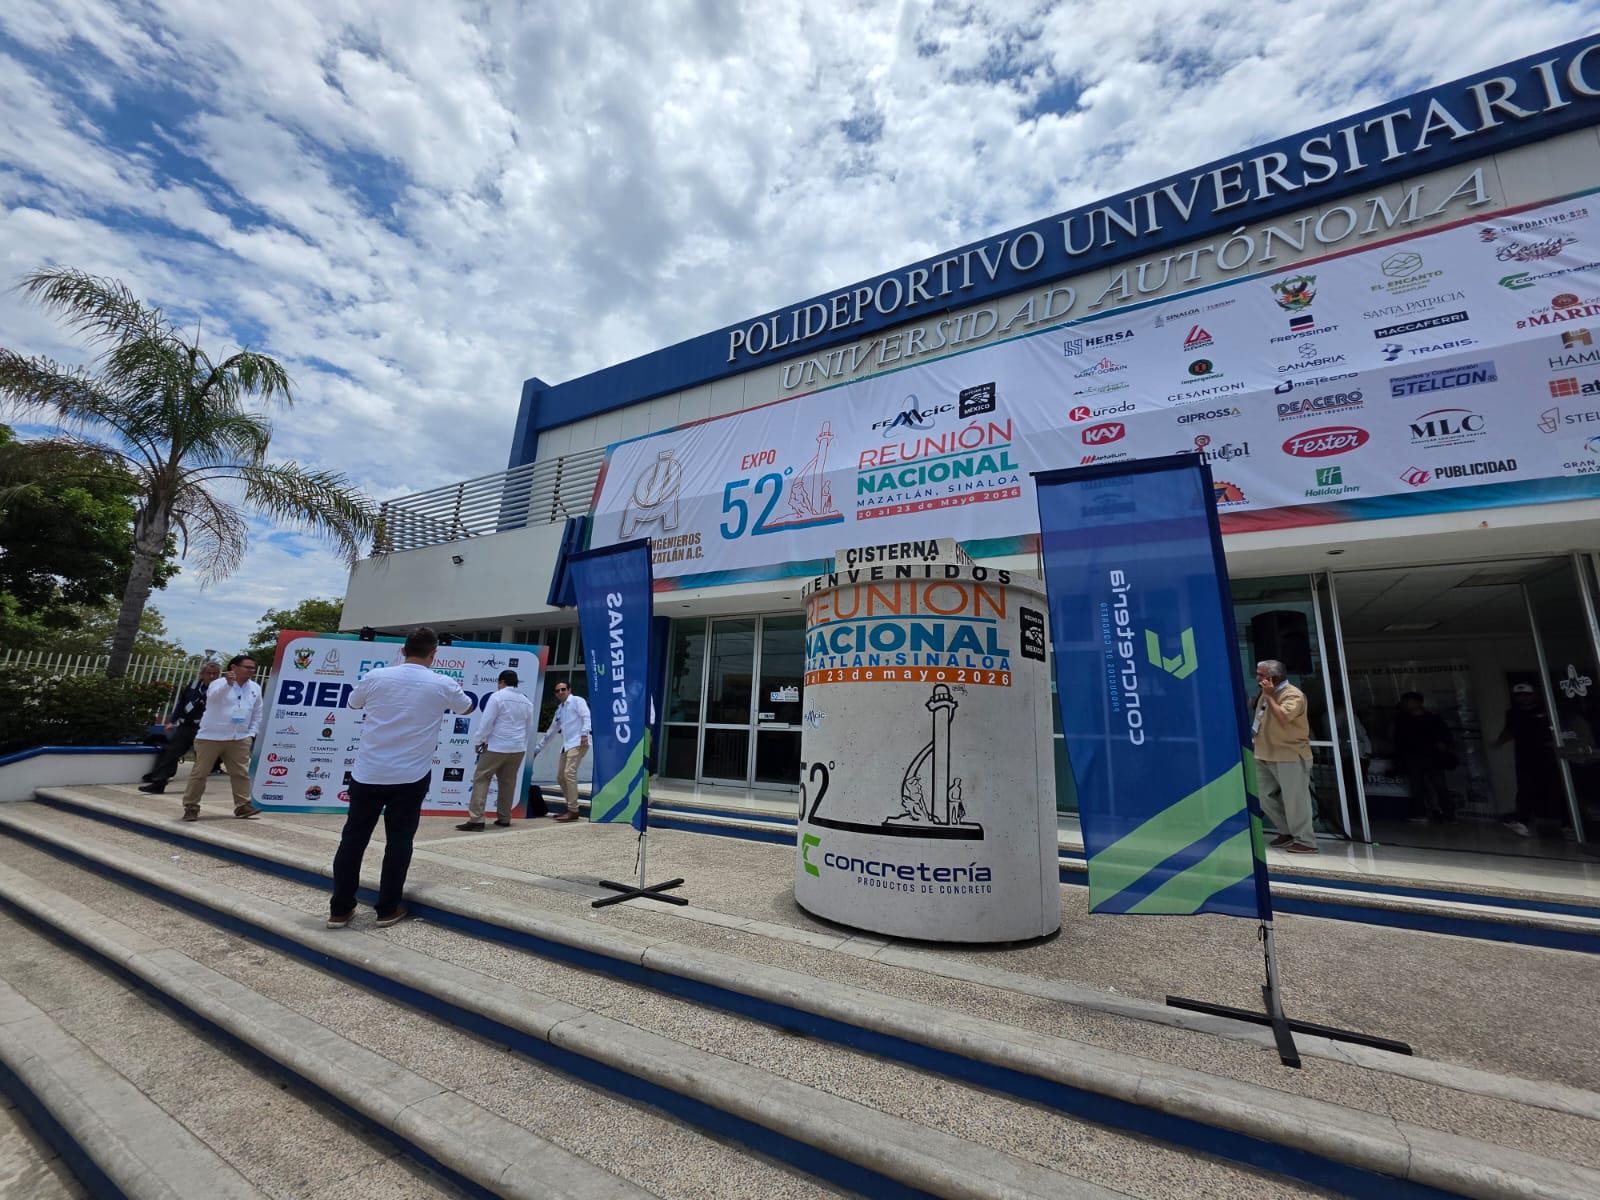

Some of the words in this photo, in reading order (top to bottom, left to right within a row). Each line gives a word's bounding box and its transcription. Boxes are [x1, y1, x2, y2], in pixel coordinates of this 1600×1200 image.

[726, 231, 1045, 362] POLIDEPORTIVO
[1058, 43, 1600, 256] UNIVERSITARIO
[783, 287, 1076, 390] UNIVERSIDAD
[1088, 168, 1492, 309] AUTÓNOMA
[1387, 270, 1443, 289] ENCANTO
[1362, 305, 1405, 320] SANTA
[1406, 290, 1466, 311] PATRICIA
[1377, 313, 1465, 337] MACCAFERRI
[1085, 329, 1134, 347] HERSA
[1277, 354, 1346, 373] SANABRIA
[1167, 382, 1246, 403] CESANTONI
[1391, 370, 1486, 398] STELCON
[1069, 400, 1136, 423] Kuroda
[1276, 389, 1363, 416] DEACERO
[1176, 407, 1241, 424] GIPROSSA
[1084, 425, 1121, 443] KAY
[1408, 414, 1485, 440] MLC
[858, 417, 1013, 470] REUNIÓN
[1288, 429, 1359, 456] Fester
[740, 449, 776, 471] EXPO
[1435, 459, 1517, 479] PUBLICIDAD
[1563, 459, 1596, 469] GRAN
[857, 451, 1019, 496] NACIONAL
[948, 475, 1019, 493] SINALOA
[1305, 487, 1342, 498] Holiday
[1343, 485, 1360, 495] Inn
[858, 510, 872, 519] 20
[878, 508, 890, 516] al
[918, 502, 933, 510] de
[941, 495, 976, 507] Mayo
[983, 489, 1018, 500] 2026
[651, 532, 701, 551] NGENIEROS
[652, 547, 685, 564] ZATLÁN
[687, 545, 704, 560] A.C.
[805, 622, 1010, 660] NACIONAL
[895, 653, 1010, 671] SINALOA
[852, 668, 873, 680] de
[883, 669, 946, 682] mayo
[957, 670, 1010, 685] 2026
[824, 852, 992, 883] concretería
[857, 876, 916, 894] PRODUCTOS
[921, 884, 934, 894] DE
[939, 884, 992, 894] CONCRETO
